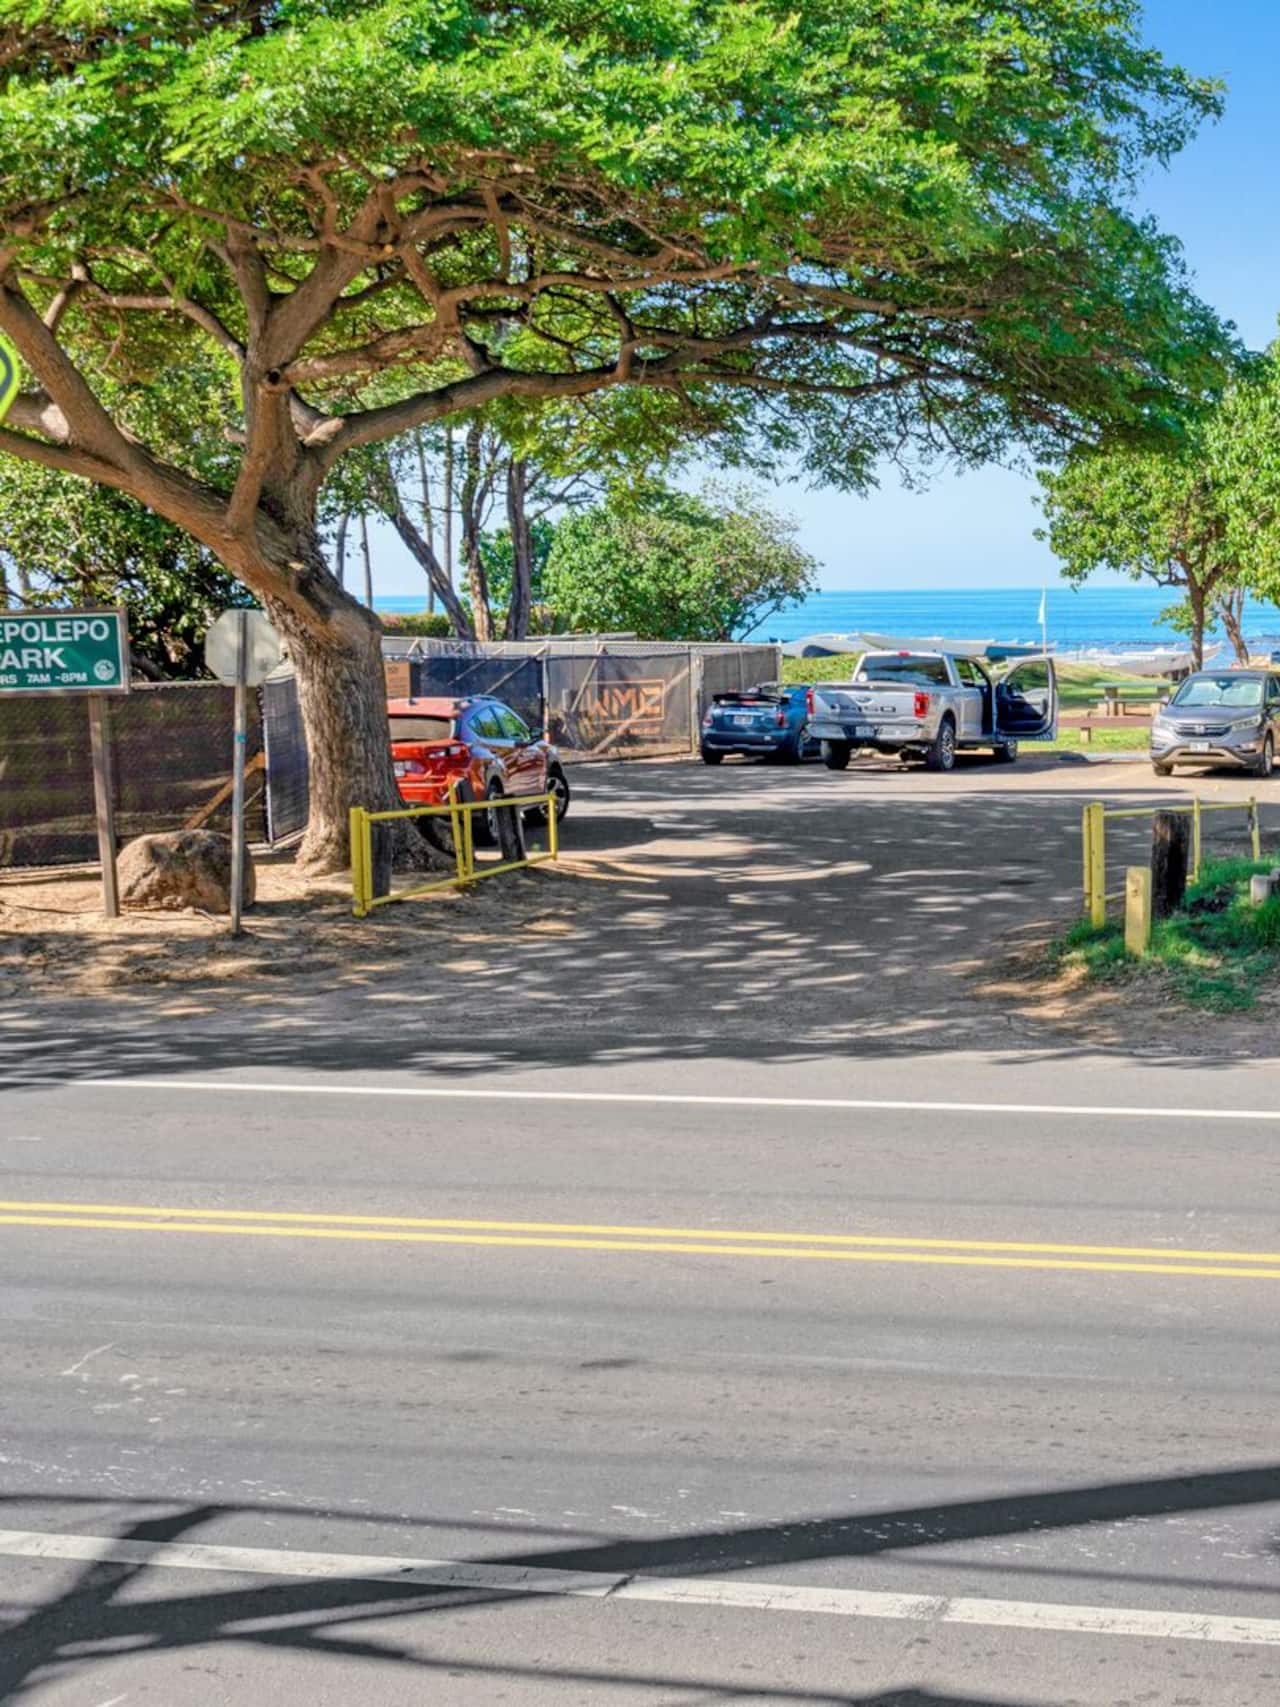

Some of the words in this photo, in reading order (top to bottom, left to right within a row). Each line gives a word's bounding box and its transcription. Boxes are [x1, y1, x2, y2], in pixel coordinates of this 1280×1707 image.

[0, 619, 109, 642] POLEPO
[0, 647, 67, 669] ARK
[26, 673, 50, 683] 7AM
